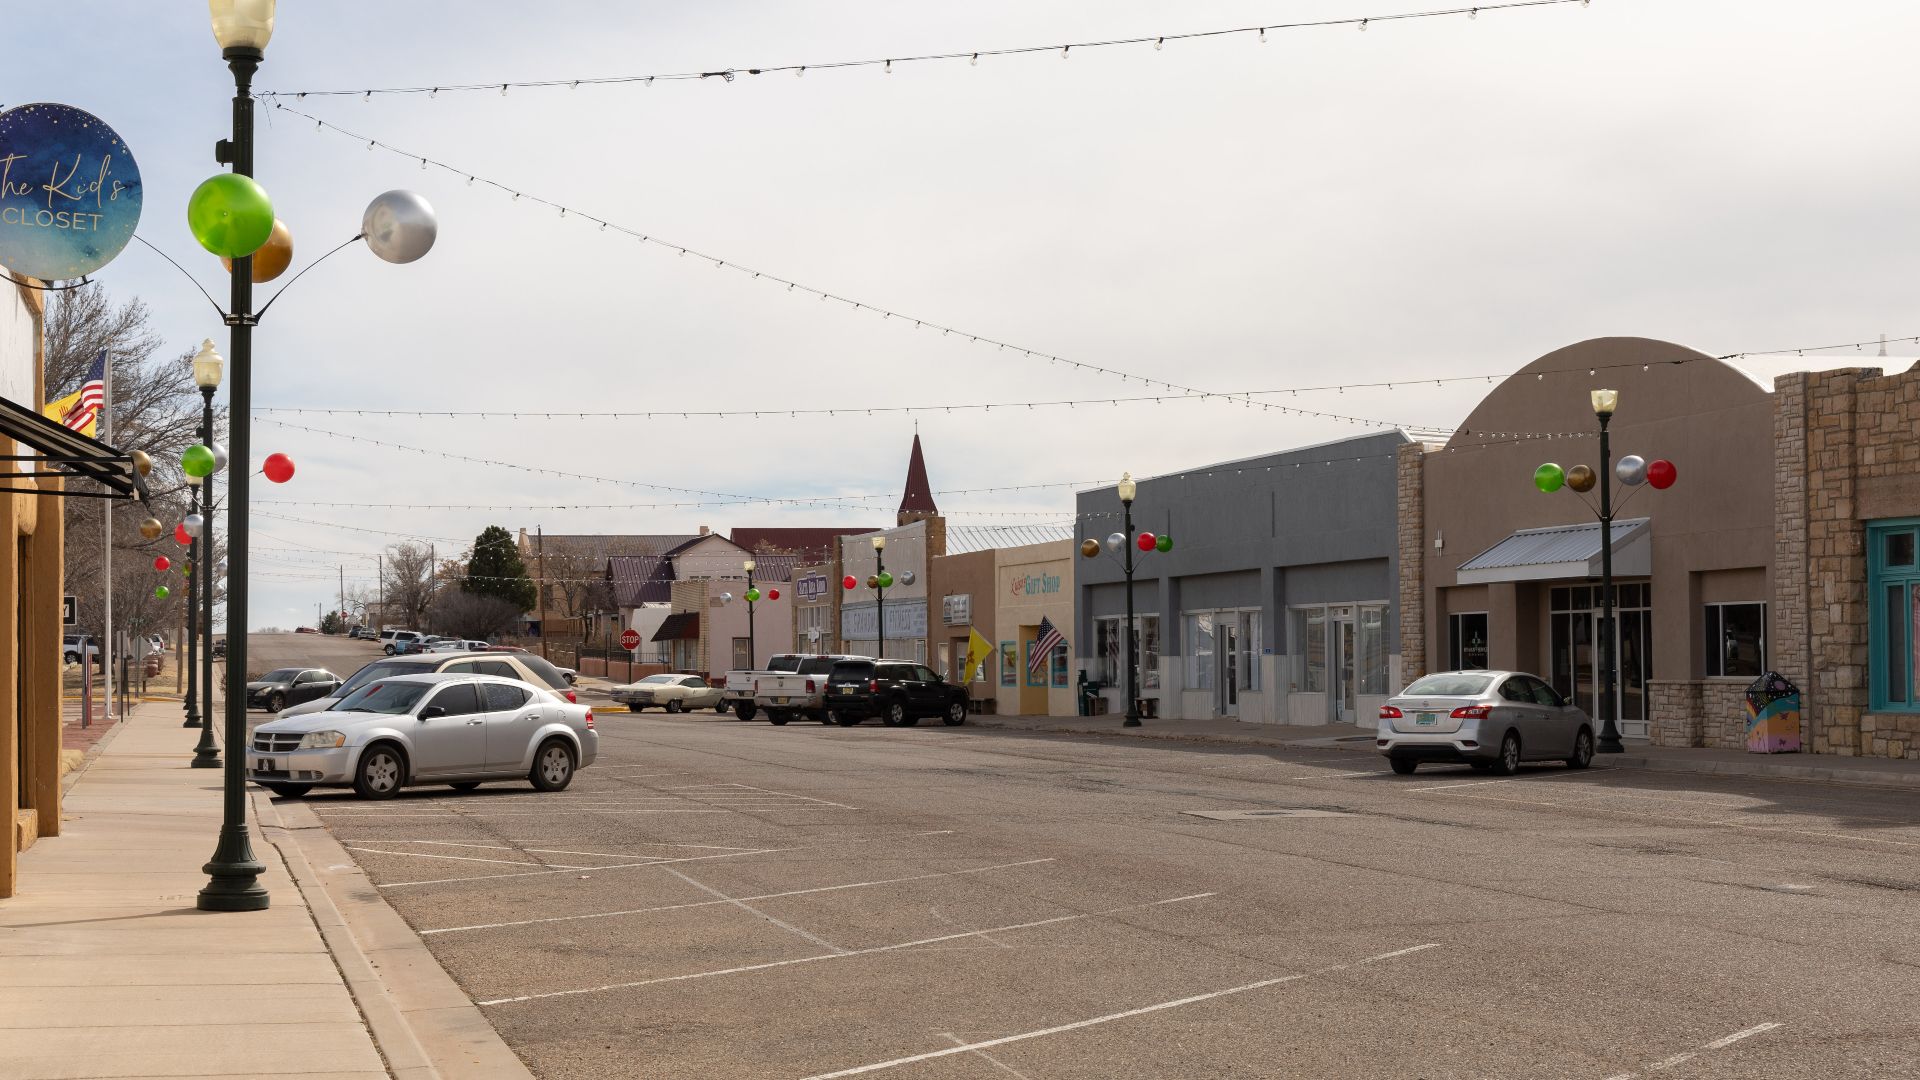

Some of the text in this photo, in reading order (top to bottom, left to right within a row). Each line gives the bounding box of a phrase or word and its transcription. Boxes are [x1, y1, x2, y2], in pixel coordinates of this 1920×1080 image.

[42, 152, 126, 208] Kid's
[2, 207, 104, 232] CLOSET
[621, 635, 639, 644] STOP
